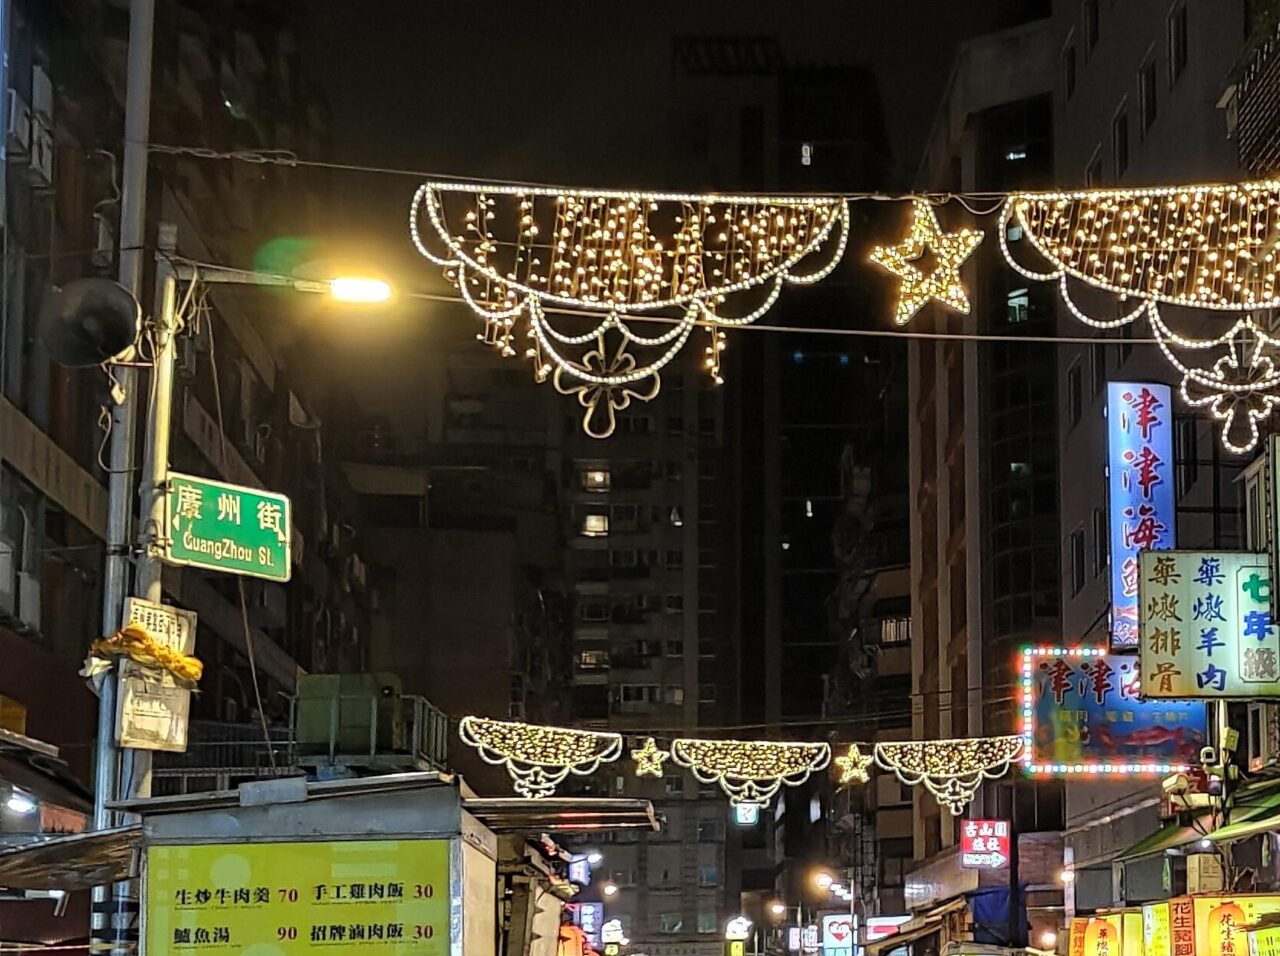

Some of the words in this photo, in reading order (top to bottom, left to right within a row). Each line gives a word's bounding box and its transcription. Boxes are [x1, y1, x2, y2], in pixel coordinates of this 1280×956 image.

[176, 484, 282, 533] 廣州街
[183, 531, 252, 562] GuangZhou
[1148, 556, 1184, 693] 藥燉排骨
[1192, 556, 1228, 692] 藥燉羊肉
[174, 886, 271, 908] 生炒牛肉羹
[277, 888, 299, 903] 70
[313, 881, 405, 902] 手工雞肉飯
[412, 883, 434, 900] 30
[173, 926, 231, 946] 鱸魚湯
[276, 926, 298, 941] 90
[412, 924, 434, 939] 30
